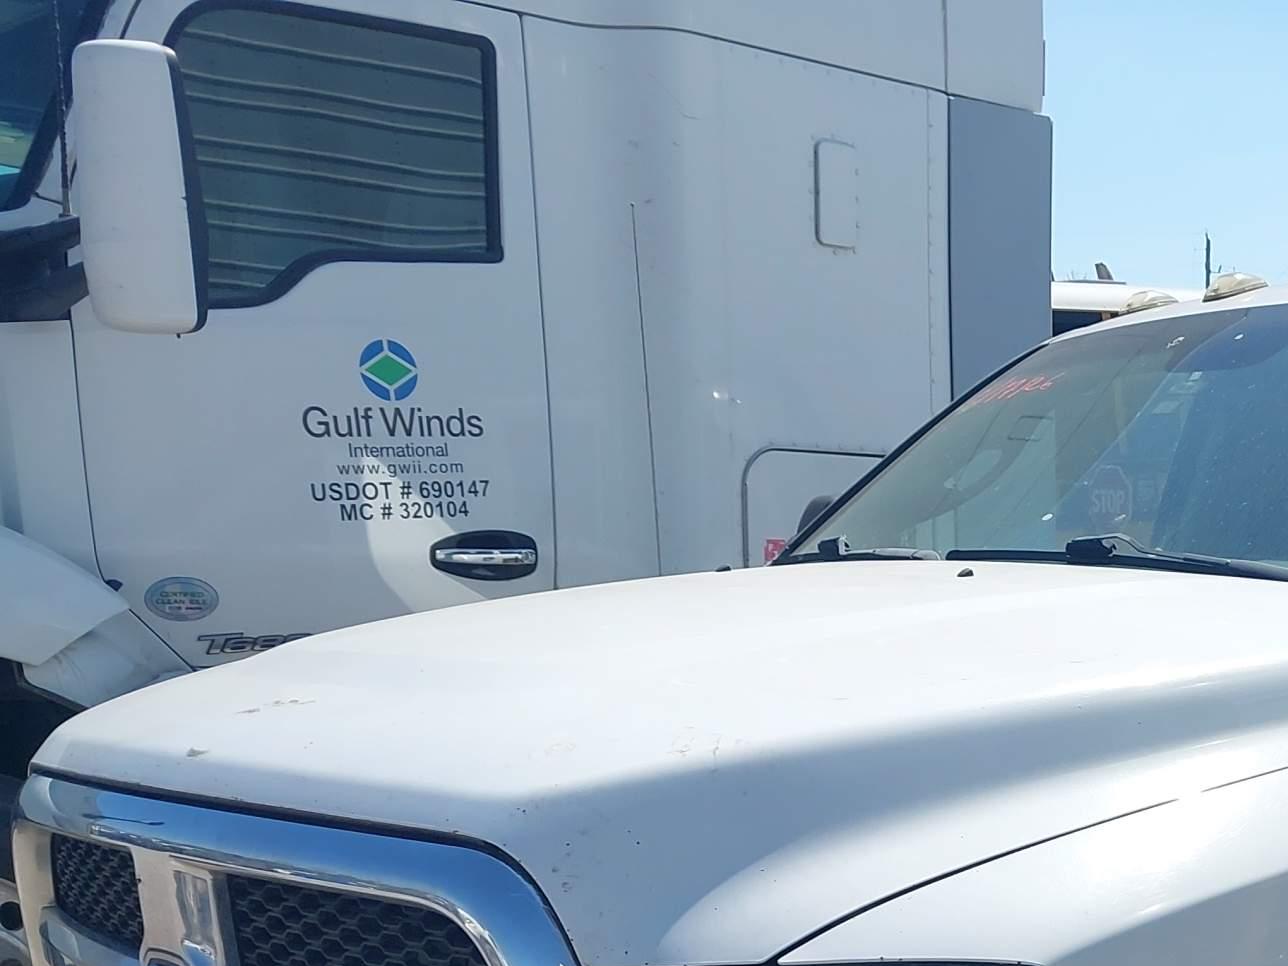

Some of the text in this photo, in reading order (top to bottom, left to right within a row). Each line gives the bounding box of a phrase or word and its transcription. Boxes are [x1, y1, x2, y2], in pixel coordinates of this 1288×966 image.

[302, 406, 485, 439] Gulf Winds
[348, 442, 449, 459] International
[337, 459, 464, 478] www.gwii.com
[310, 479, 490, 502] USDOT # 690147
[1091, 488, 1125, 513] STOP
[339, 501, 470, 521] MC # 320104
[197, 632, 312, 655] T68
